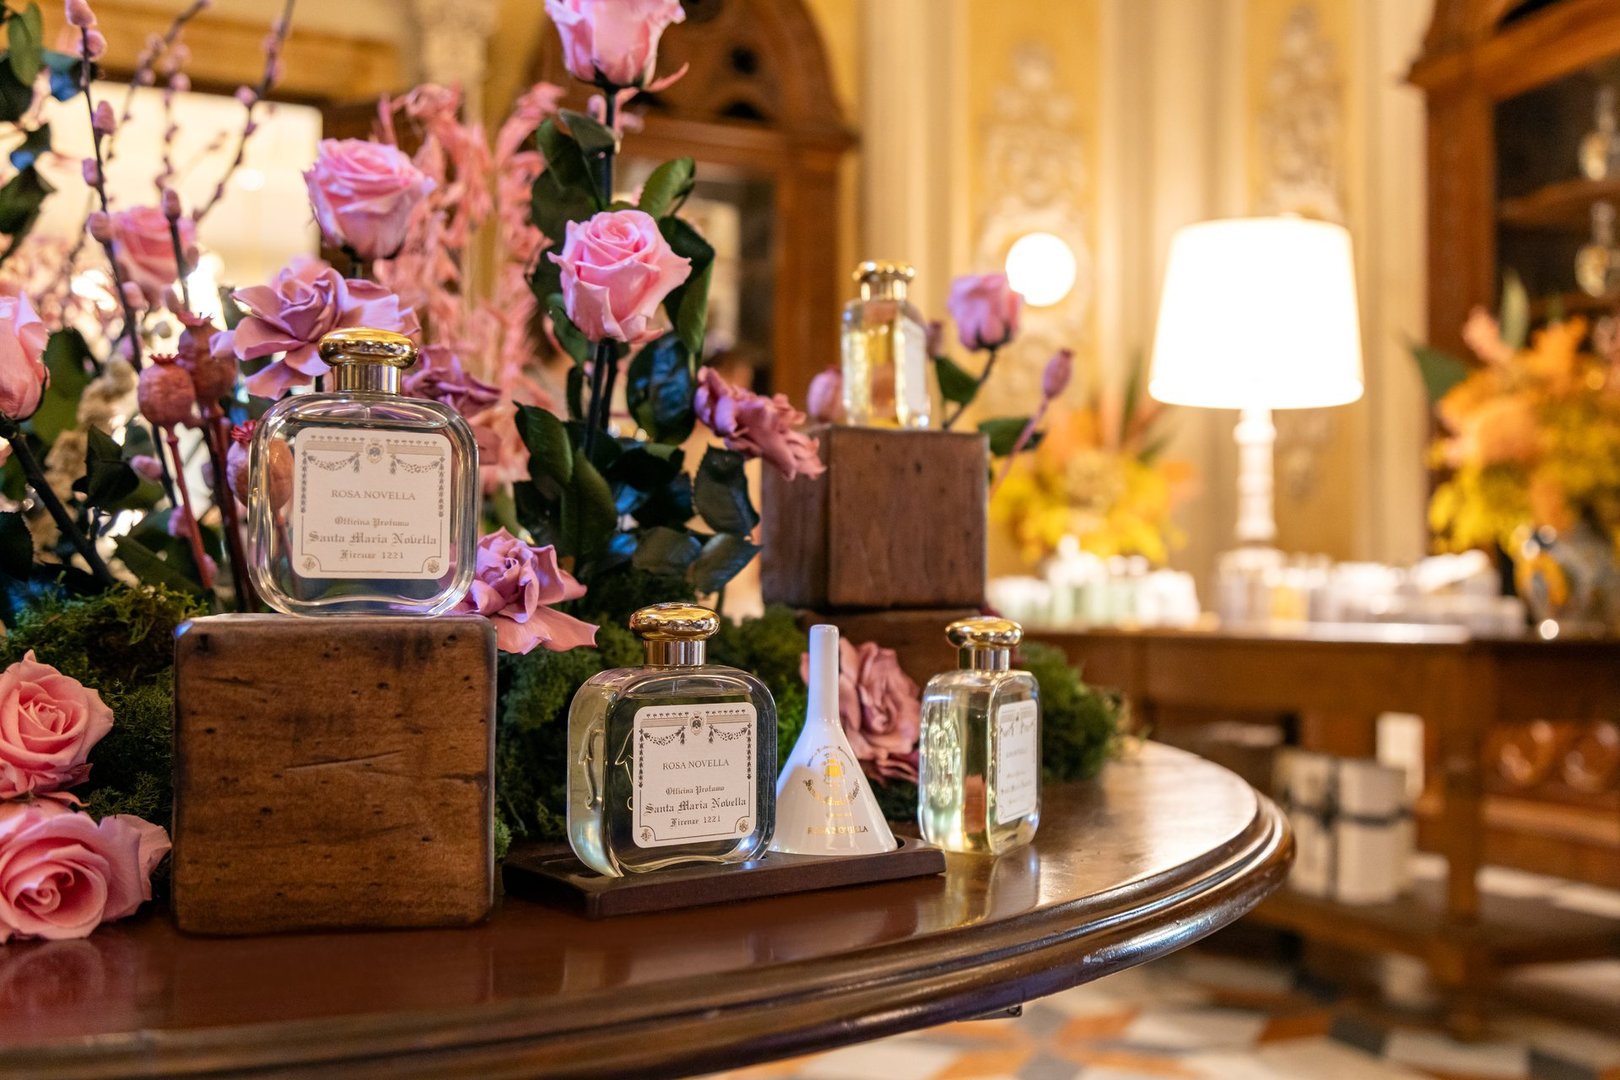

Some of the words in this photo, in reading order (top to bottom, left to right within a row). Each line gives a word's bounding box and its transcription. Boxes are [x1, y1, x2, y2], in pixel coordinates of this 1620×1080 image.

[331, 489, 361, 499] ROSA
[363, 490, 416, 501] NOVELLA
[334, 516, 370, 526] Officina
[372, 517, 410, 528] Profumo
[307, 530, 345, 545] Santa
[349, 531, 388, 546] Maria
[392, 532, 437, 546] Novella
[339, 548, 376, 561] Firenze
[382, 551, 404, 560] 1221
[662, 762, 687, 771] ROSA
[688, 759, 730, 769] NOVELLA
[665, 786, 694, 795] Officina
[695, 785, 725, 795] Profumo
[643, 802, 675, 816] Santa
[677, 799, 708, 813] Maria
[711, 796, 747, 810] Novella
[670, 817, 699, 828] Firenze
[703, 815, 721, 824] 1221
